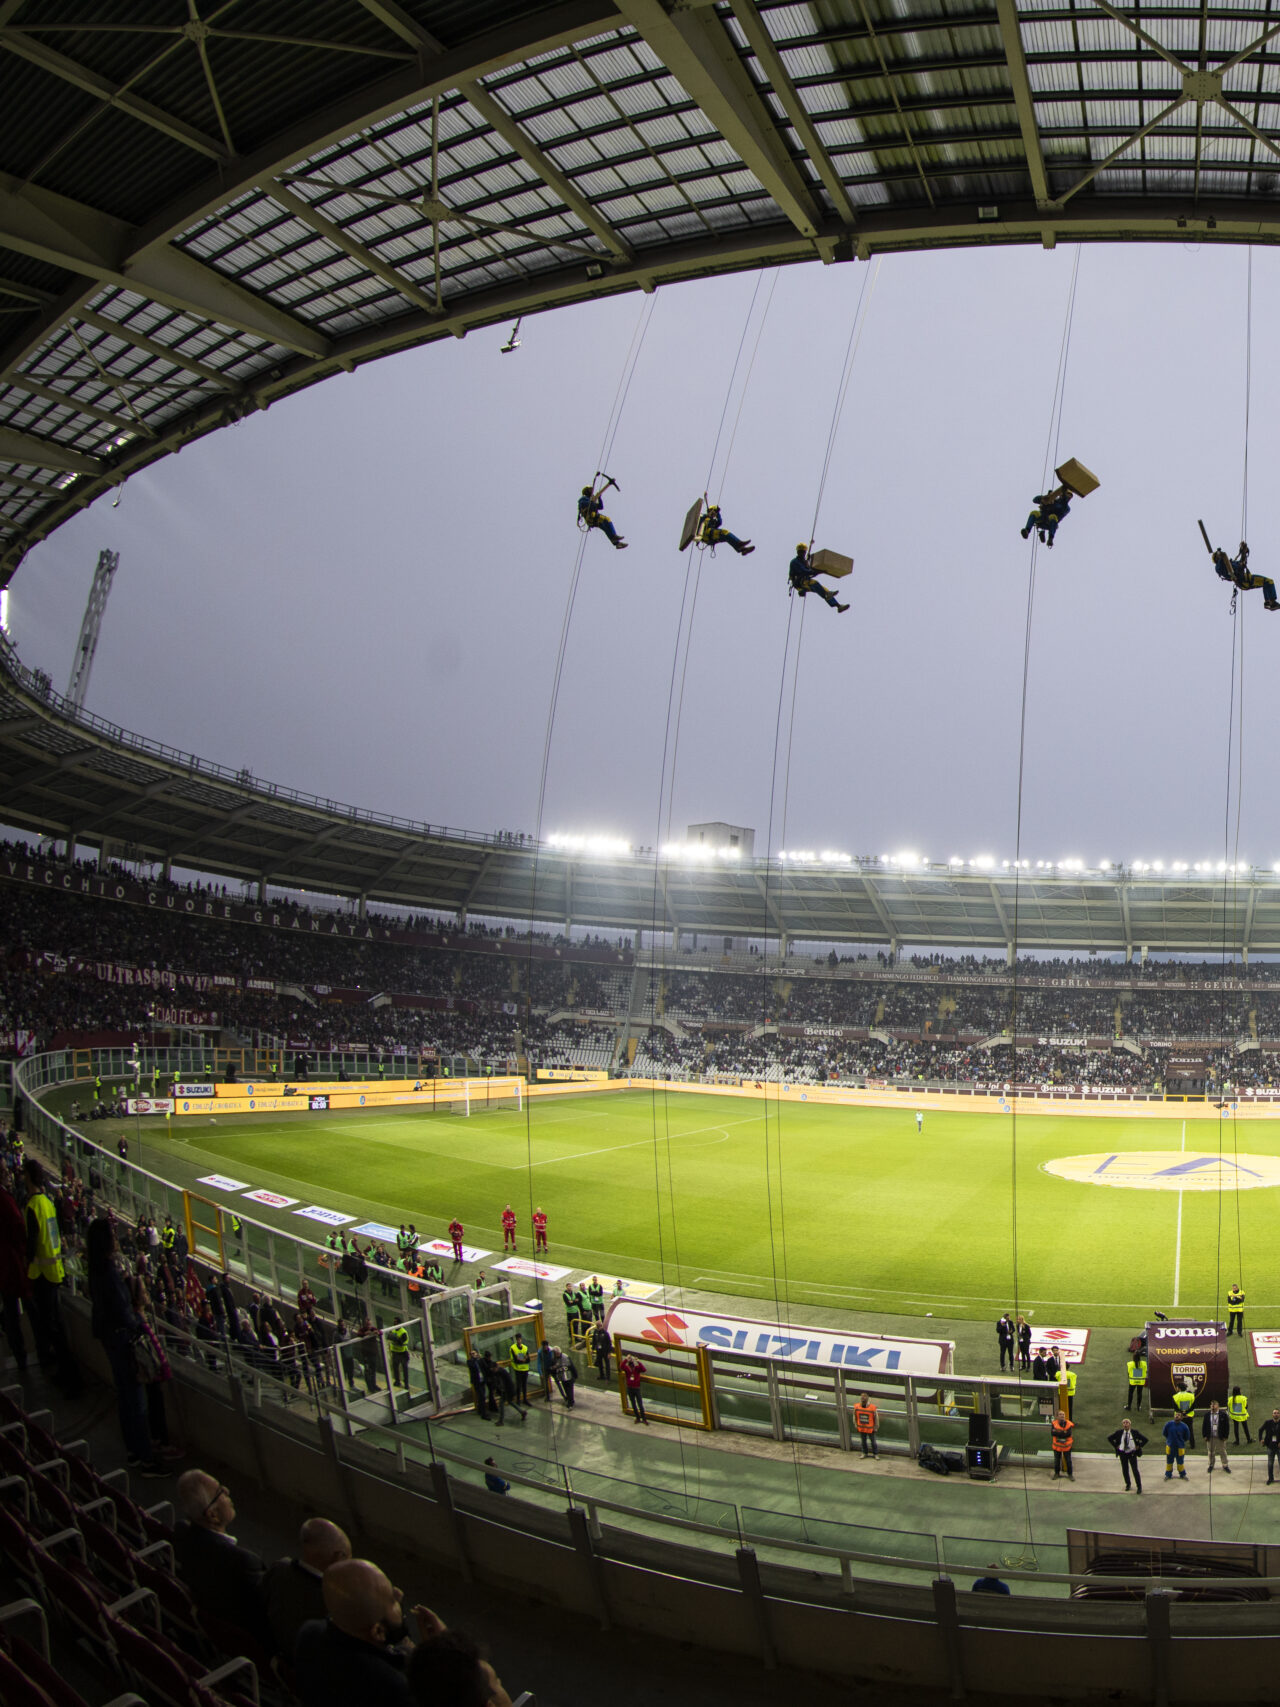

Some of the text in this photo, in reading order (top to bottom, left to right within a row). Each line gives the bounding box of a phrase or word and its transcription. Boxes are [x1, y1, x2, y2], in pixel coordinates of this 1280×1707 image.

[8, 861, 374, 938] VECCHIO CUORE GRANATA
[1051, 978, 1091, 987] GERLA
[804, 1028, 843, 1036] Beretta
[1050, 1038, 1087, 1046] SUZUKI
[1043, 1085, 1073, 1093] Beretta
[696, 1324, 902, 1371] SUZUKI
